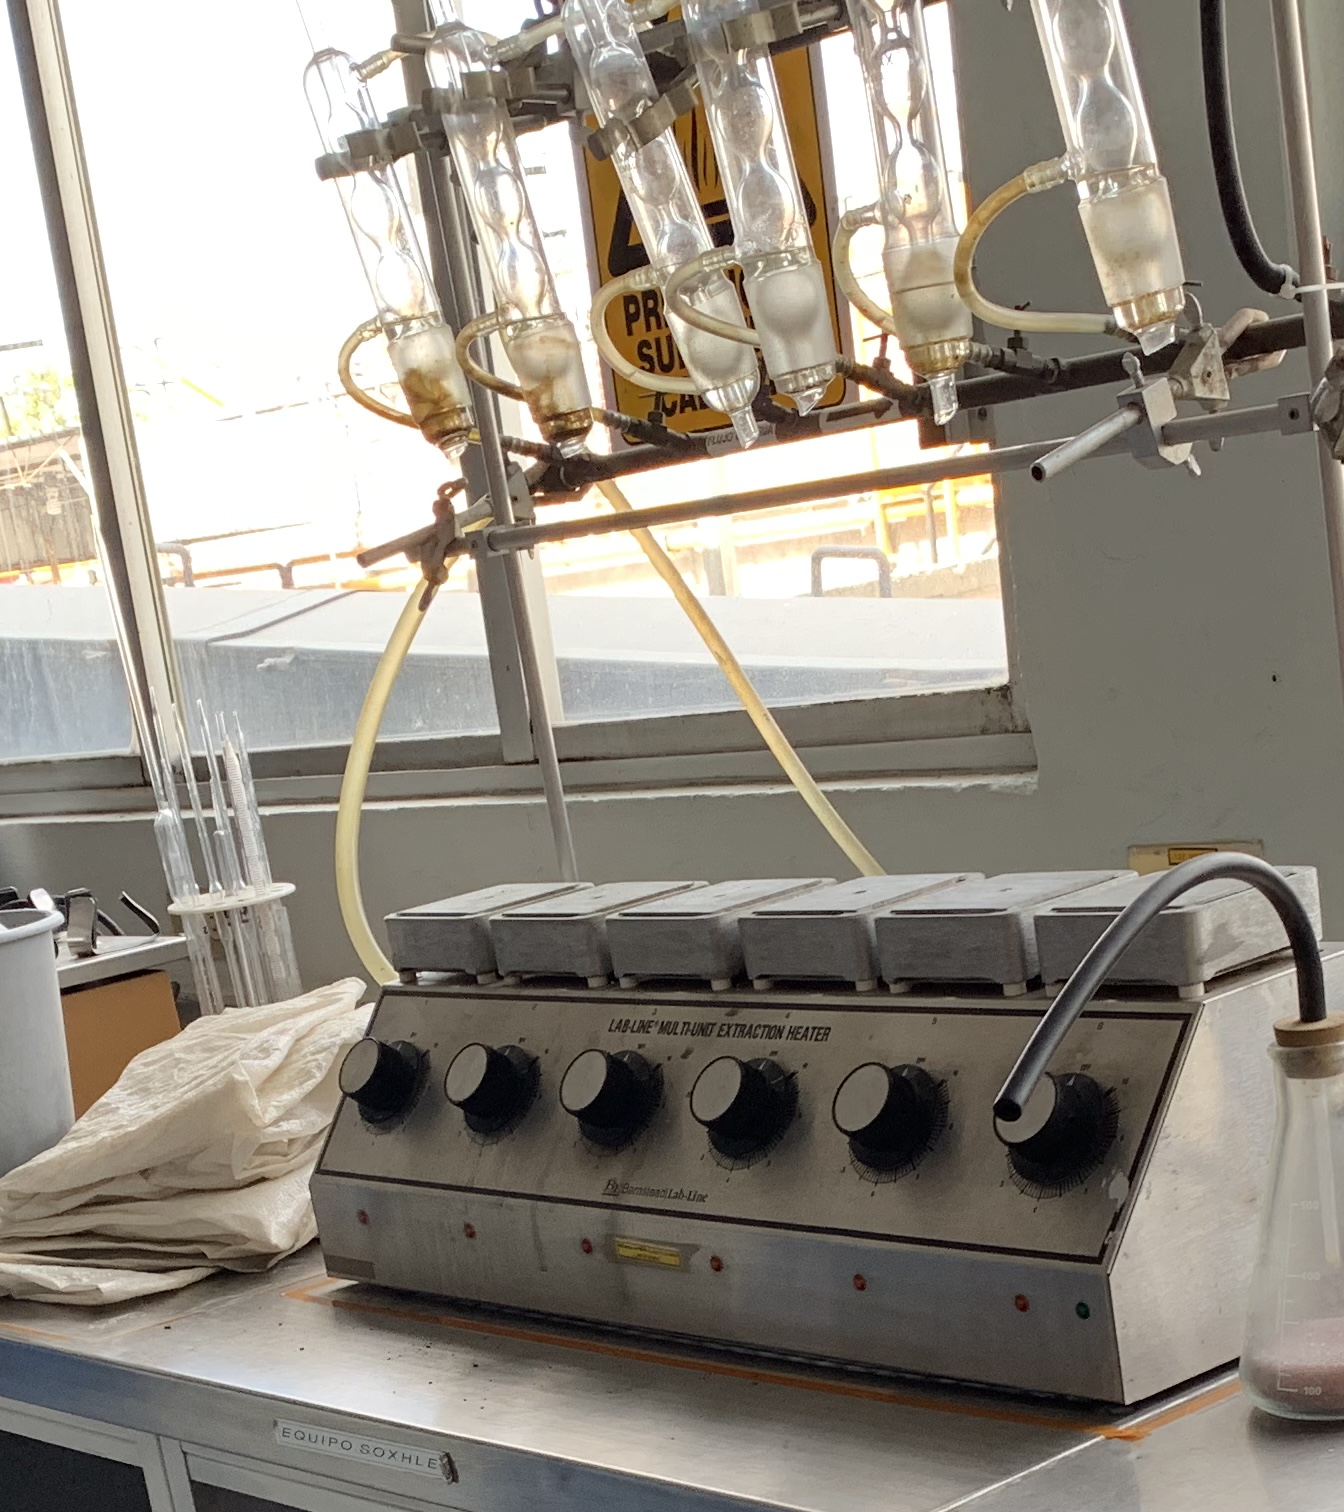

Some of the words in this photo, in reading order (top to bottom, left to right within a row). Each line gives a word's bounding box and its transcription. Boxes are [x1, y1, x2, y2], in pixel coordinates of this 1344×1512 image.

[657, 1021, 715, 1037] MULTI-UNIT
[716, 1023, 786, 1041] EXTRACTION
[785, 1025, 832, 1042] HEATER
[1303, 1386, 1322, 1396] 100
[282, 1427, 353, 1451] EQUIPO
[360, 1443, 438, 1470] SOXHLE
